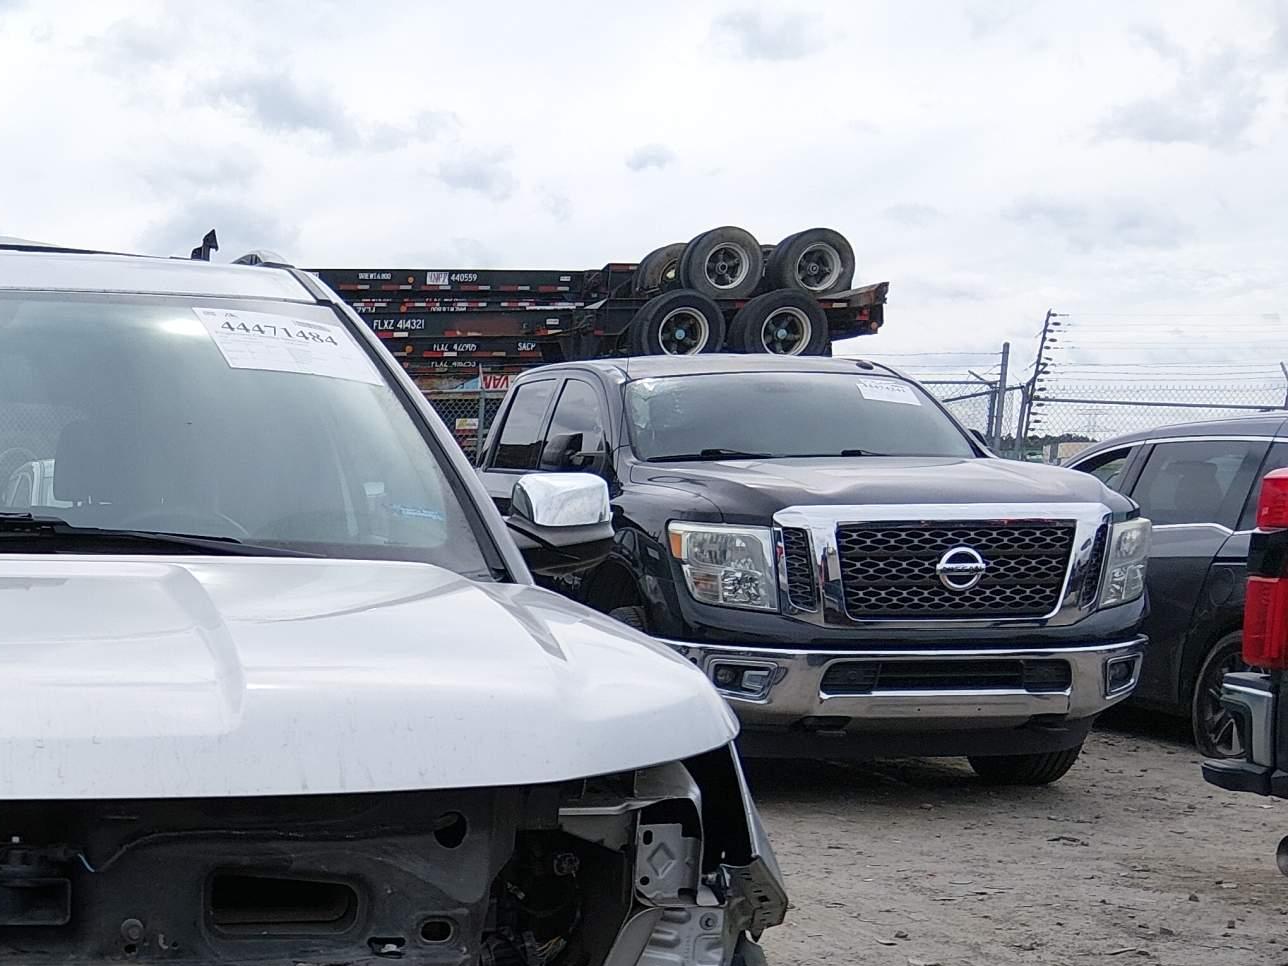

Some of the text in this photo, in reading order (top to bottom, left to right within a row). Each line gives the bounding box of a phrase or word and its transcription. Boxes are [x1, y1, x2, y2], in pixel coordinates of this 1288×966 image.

[451, 273, 478, 282] 440559
[373, 318, 425, 330] FLXZ 414321
[220, 320, 339, 347] 44471484
